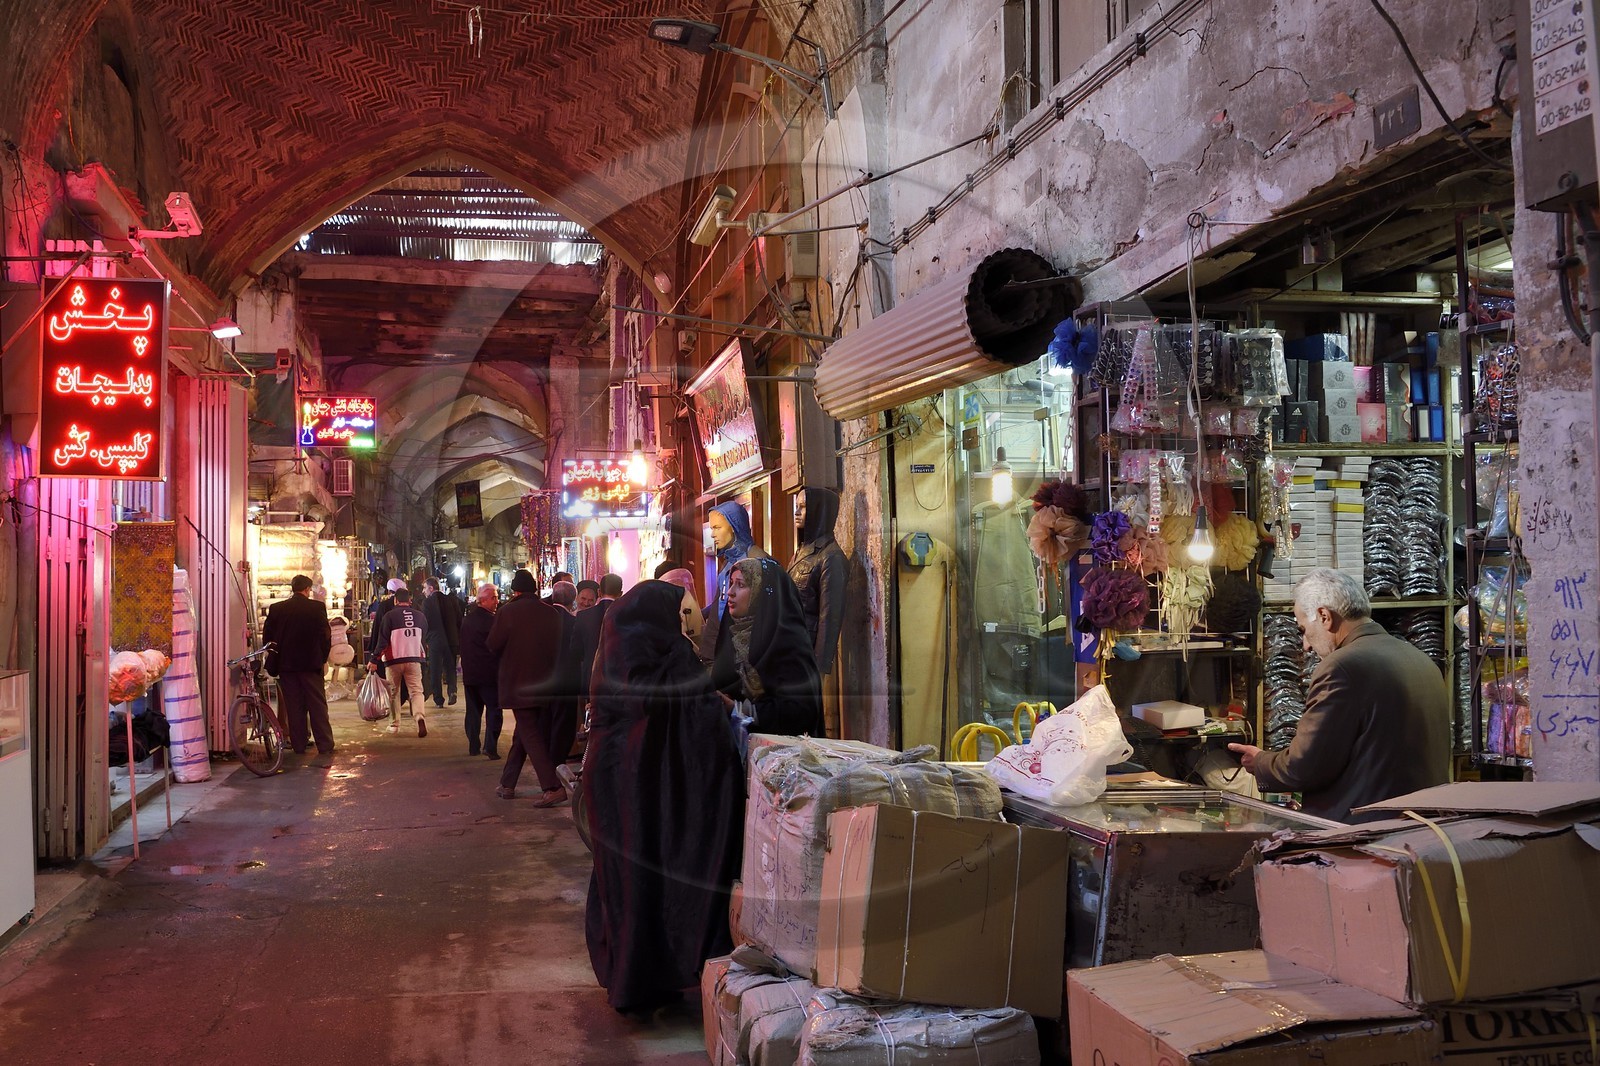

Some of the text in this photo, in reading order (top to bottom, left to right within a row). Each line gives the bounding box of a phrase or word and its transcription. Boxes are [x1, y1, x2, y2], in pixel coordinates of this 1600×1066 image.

[1536, 18, 1584, 51] 00-52-143
[1539, 58, 1586, 90] 00-52-144
[1541, 97, 1590, 128] 00-52-149
[50, 285, 153, 356] پخش
[56, 366, 153, 407] بدلیجات
[403, 610, 414, 627] JRD
[404, 629, 416, 637] 01
[1496, 1051, 1567, 1066] TEXTILE
